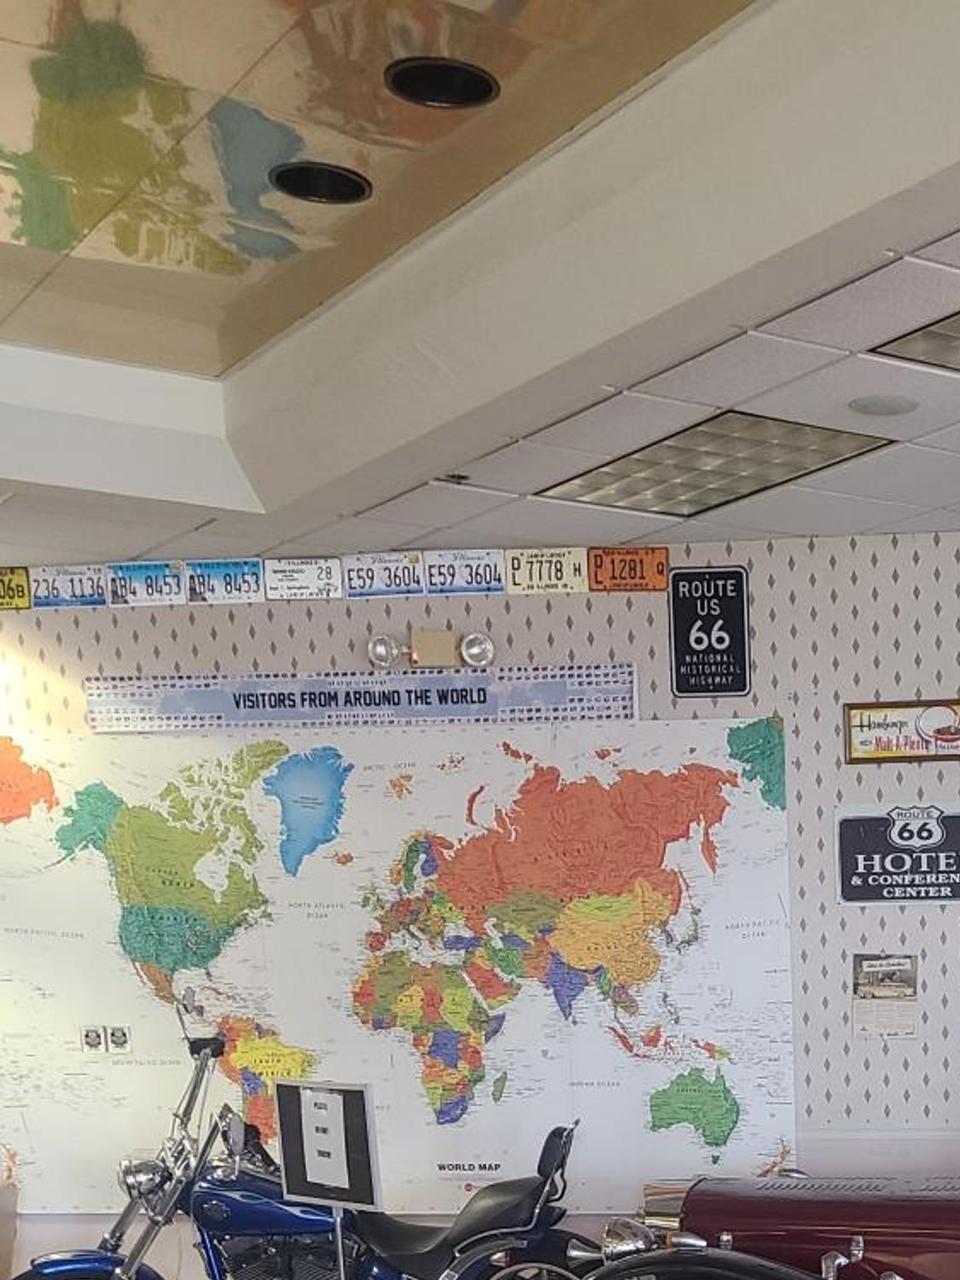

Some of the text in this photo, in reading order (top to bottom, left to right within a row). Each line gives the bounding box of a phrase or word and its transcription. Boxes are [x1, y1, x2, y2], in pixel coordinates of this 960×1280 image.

[317, 566, 333, 581] 28
[347, 565, 421, 590] E59 3604
[428, 563, 502, 586] E59 3604
[526, 560, 564, 582] 7778
[609, 559, 646, 581] 1281
[33, 577, 105, 599] 236 1136
[146, 574, 181, 596] 8453
[224, 572, 260, 594] 8453
[679, 580, 737, 597] ROUTE
[697, 599, 720, 616] US
[689, 619, 730, 651] 66
[232, 687, 487, 710] VISITORS FROM AROUND THE WORLD
[896, 809, 934, 819] ROUTE
[897, 822, 934, 842] 66
[851, 874, 863, 886] &
[883, 886, 953, 898] CENTER
[437, 1163, 501, 1171] WORLD MAP
